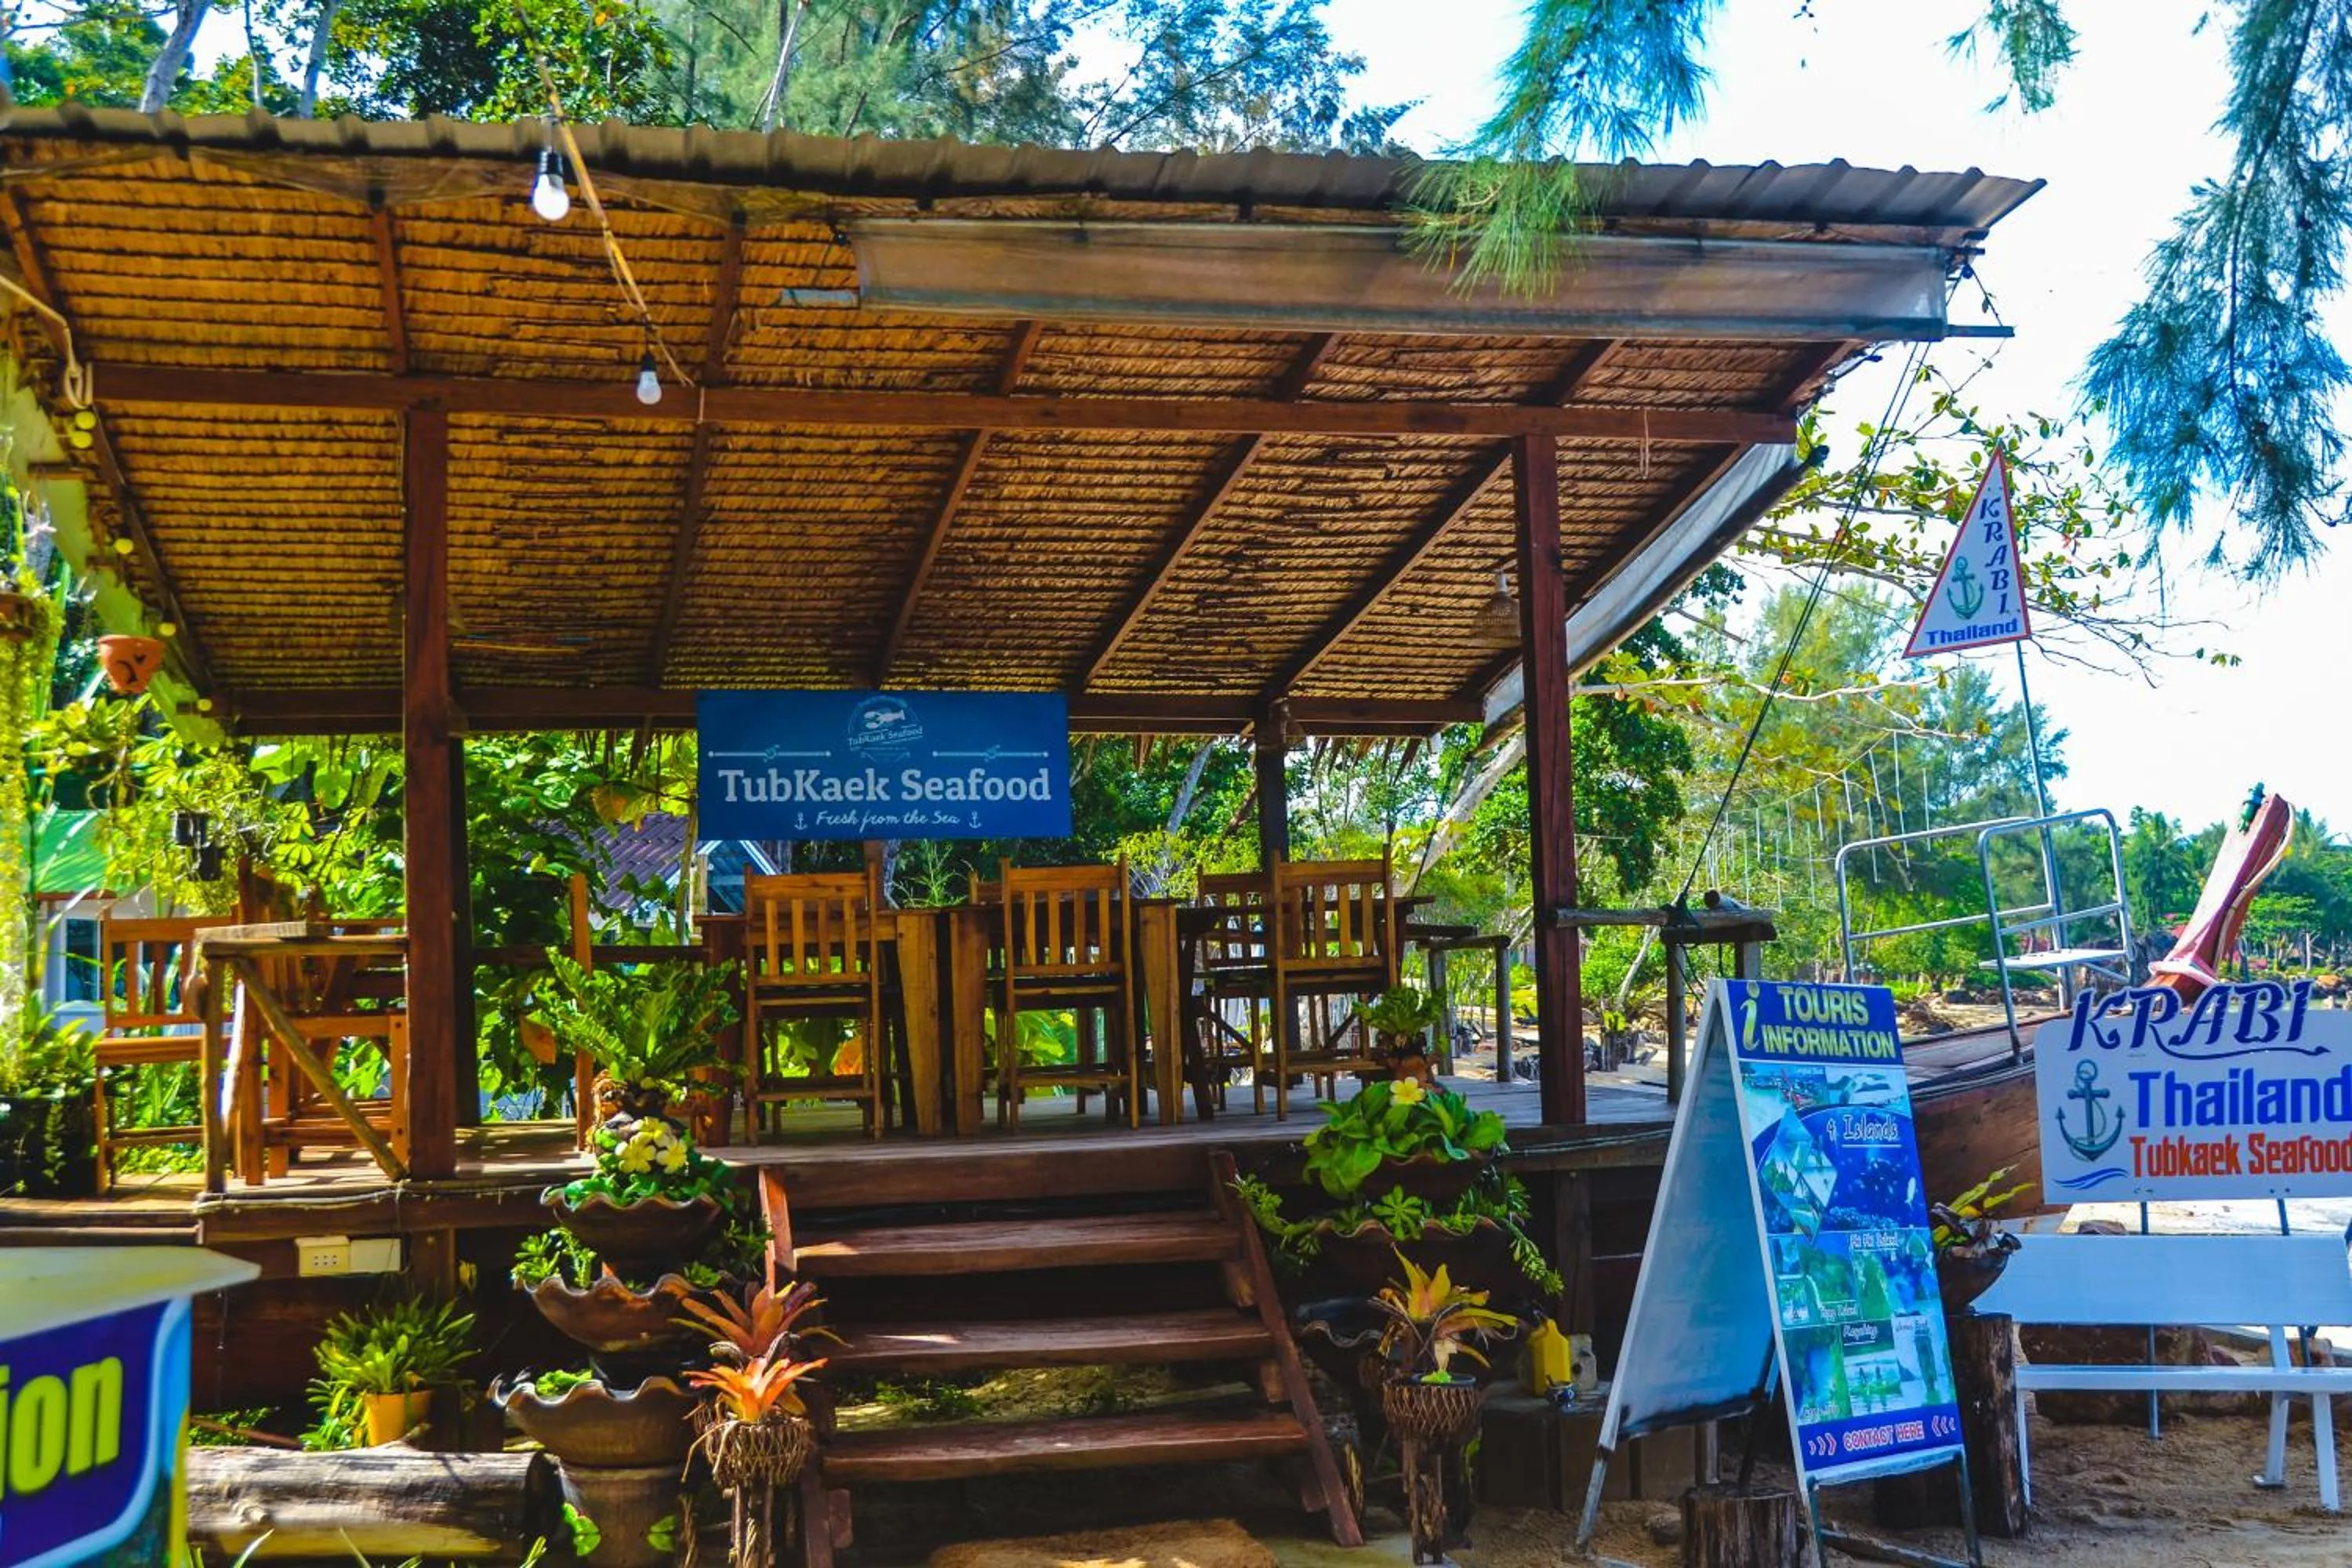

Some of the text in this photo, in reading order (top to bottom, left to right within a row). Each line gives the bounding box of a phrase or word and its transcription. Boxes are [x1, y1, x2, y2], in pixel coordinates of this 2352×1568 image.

[1980, 497, 2009, 614] KRABI
[1926, 618, 2017, 646] Thailand
[718, 767, 1051, 802] TubKaek Seafood
[816, 809, 960, 833] Fresh from the Sea
[1777, 985, 1870, 1026] TOURIS
[2067, 980, 2330, 1060] KRABI
[1761, 1025, 1896, 1058] INFORMATION
[2128, 1064, 2352, 1128] Thailand
[1843, 1113, 1899, 1142] Islands
[2129, 1133, 2242, 1178] Tubkaek
[1895, 1420, 1925, 1443] HERE
